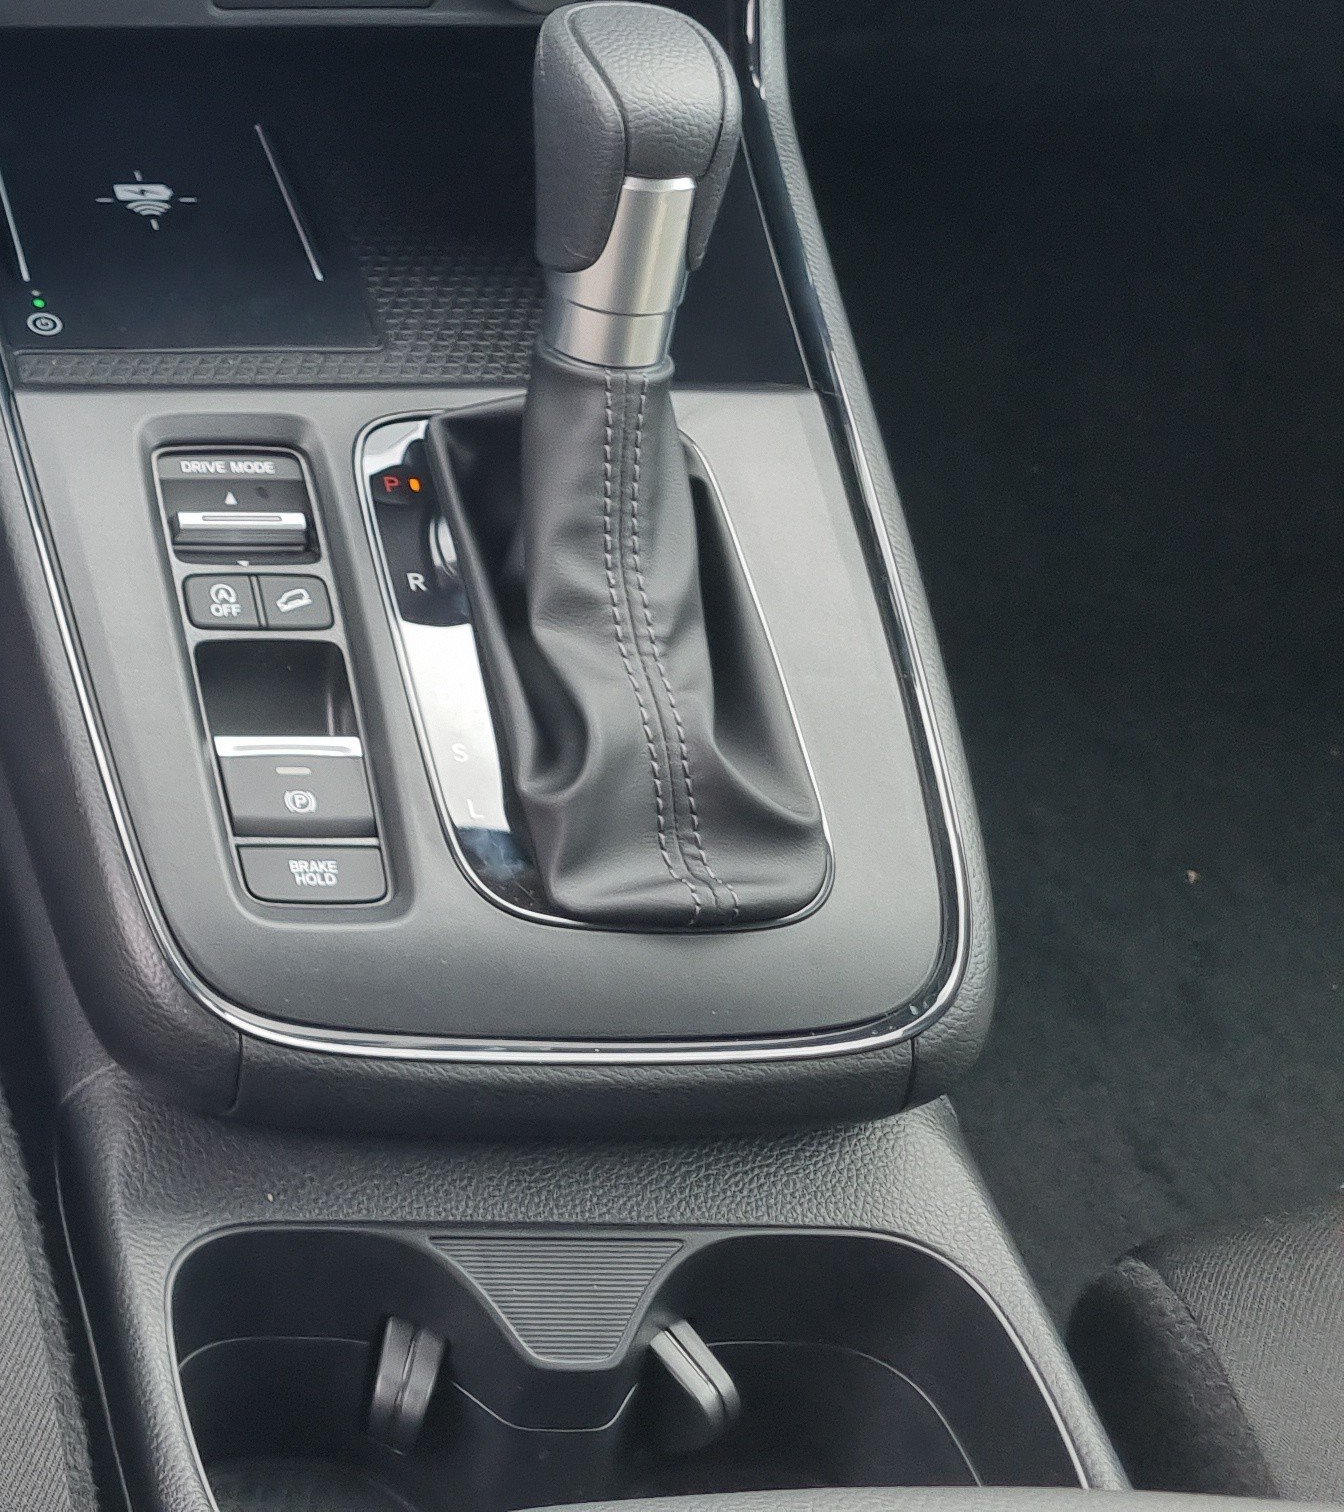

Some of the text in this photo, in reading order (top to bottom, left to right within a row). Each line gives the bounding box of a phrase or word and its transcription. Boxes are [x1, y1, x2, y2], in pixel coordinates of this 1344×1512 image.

[180, 460, 275, 476] DRIVE MODE
[384, 474, 400, 493] P
[406, 571, 428, 593] R
[210, 603, 242, 618] OFF
[450, 742, 469, 764] S
[466, 799, 485, 820] L
[288, 859, 339, 875] BRAKE
[294, 872, 338, 887] HOLD
